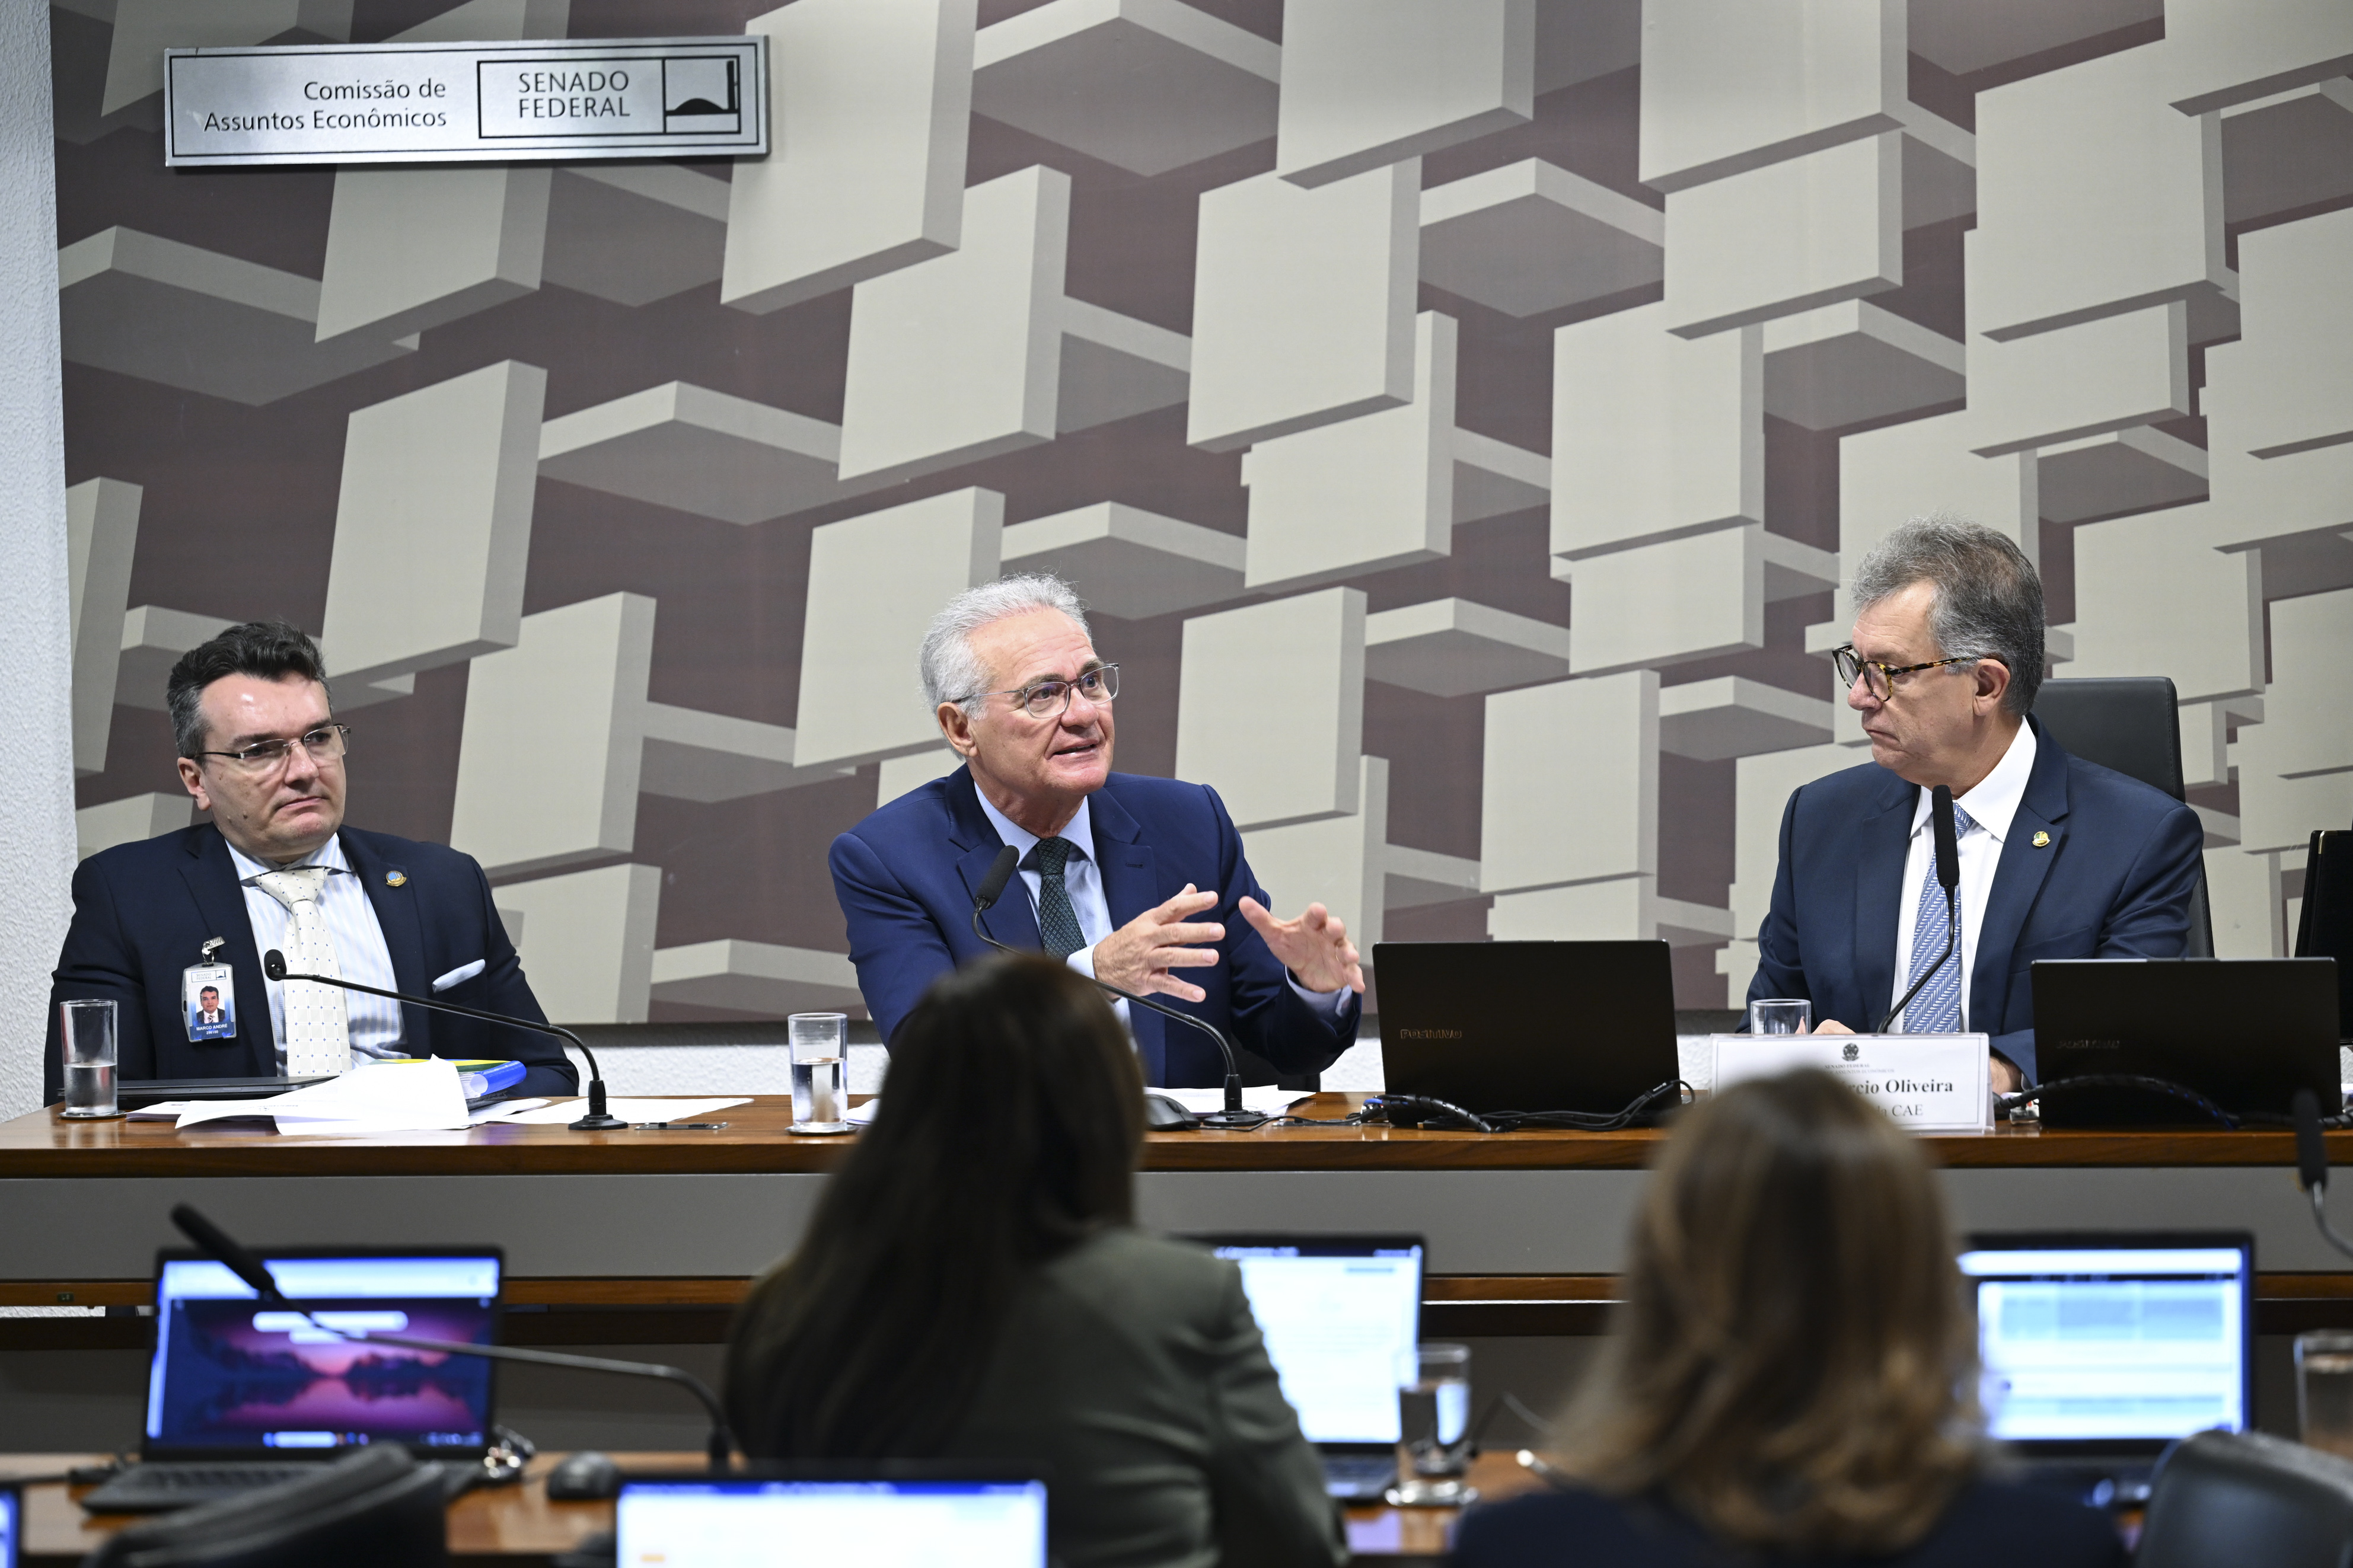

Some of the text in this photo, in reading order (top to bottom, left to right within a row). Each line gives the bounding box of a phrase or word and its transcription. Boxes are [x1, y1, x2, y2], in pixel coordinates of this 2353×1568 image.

[304, 78, 446, 100] Comissão de
[518, 71, 629, 93] SENADO
[519, 96, 630, 119] FEDERAL
[203, 108, 447, 132] Assuntos Econômicos
[1886, 1079, 1953, 1093] Oliveira
[1892, 1104, 1923, 1117] CAE
